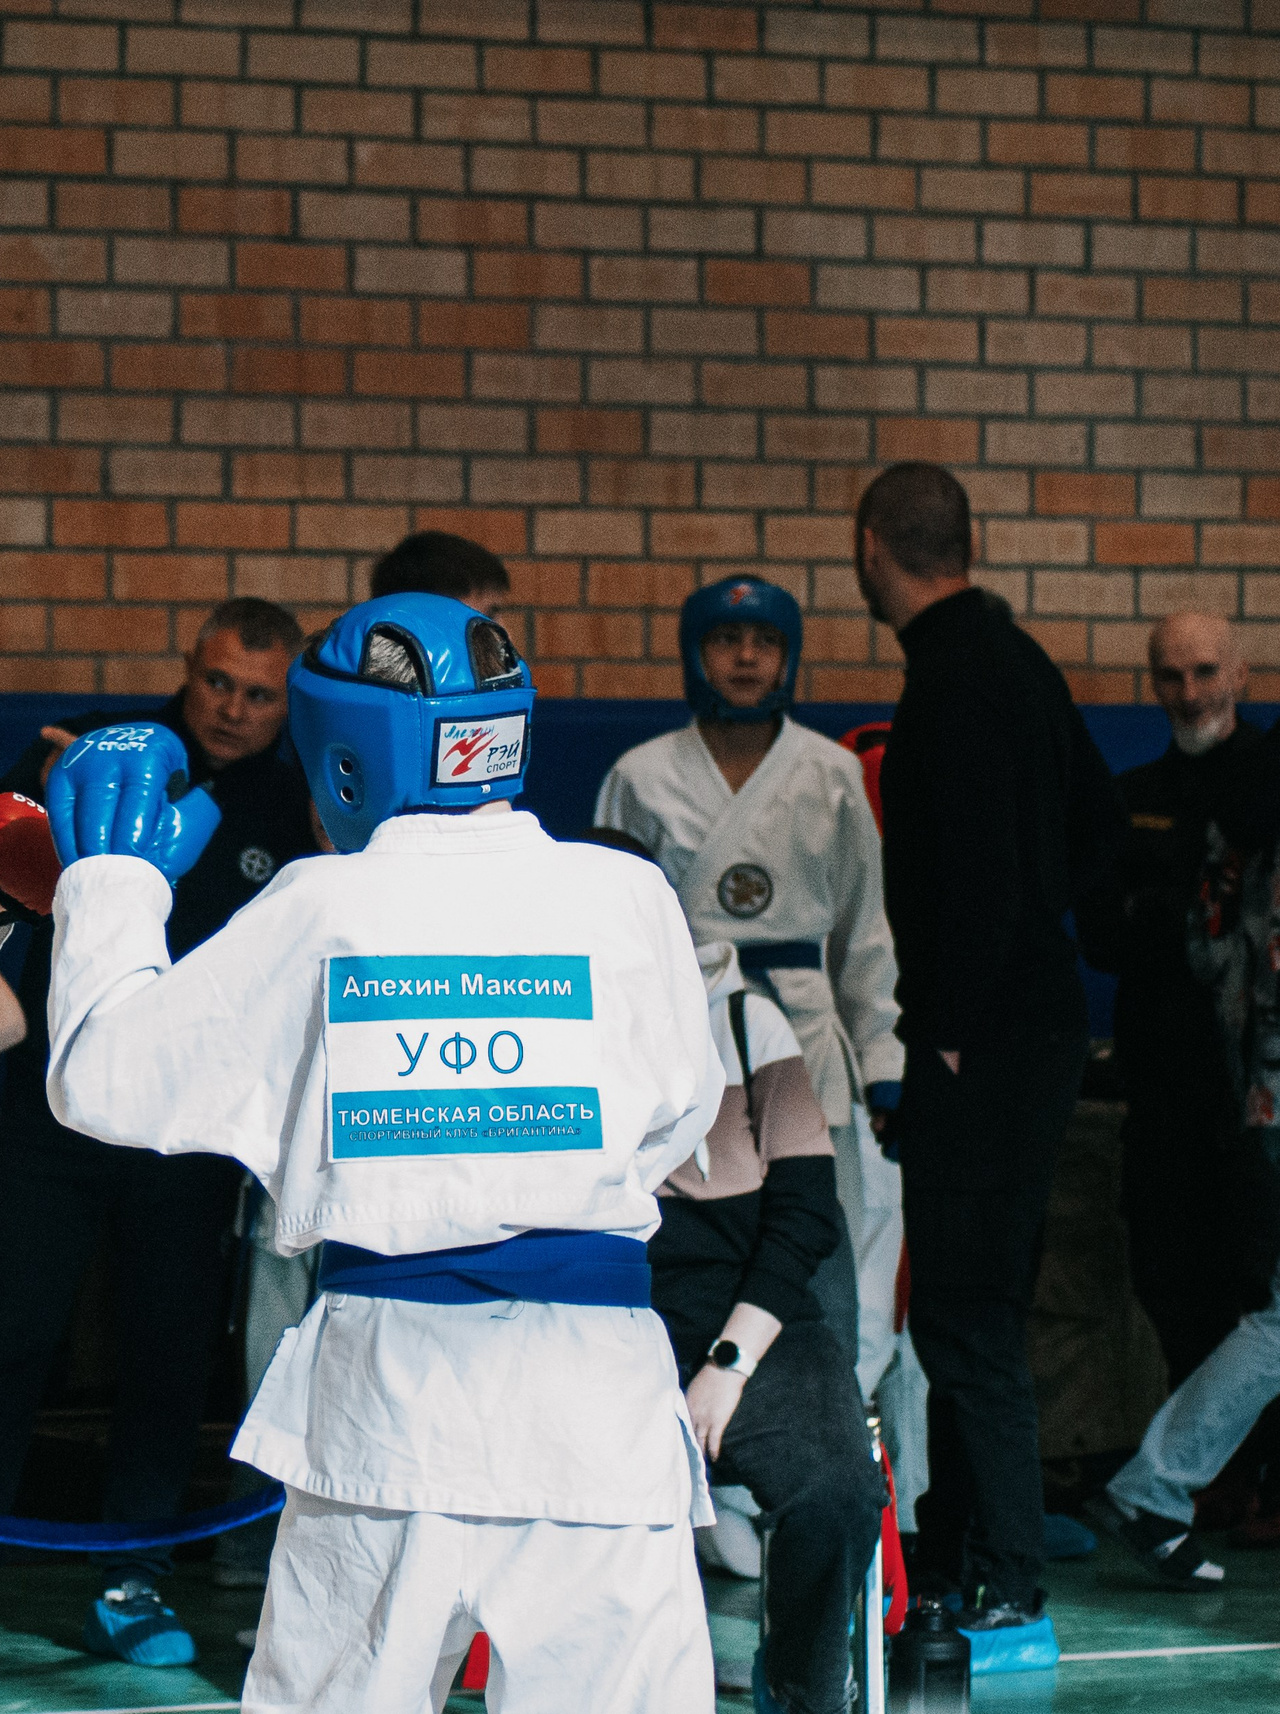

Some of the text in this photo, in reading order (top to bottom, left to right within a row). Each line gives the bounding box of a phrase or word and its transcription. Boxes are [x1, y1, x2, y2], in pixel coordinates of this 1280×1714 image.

[486, 739, 521, 763] РЭЙ
[486, 760, 518, 774] СПОРТ
[342, 973, 572, 998] Алехин Максим
[396, 1030, 524, 1076] УФО
[338, 1103, 594, 1126] ТЮМЕНСКАЯ ОБЛАСТЬ
[349, 1126, 442, 1141] СПОРТИВНЫЙ
[445, 1128, 479, 1139] КЛУБ
